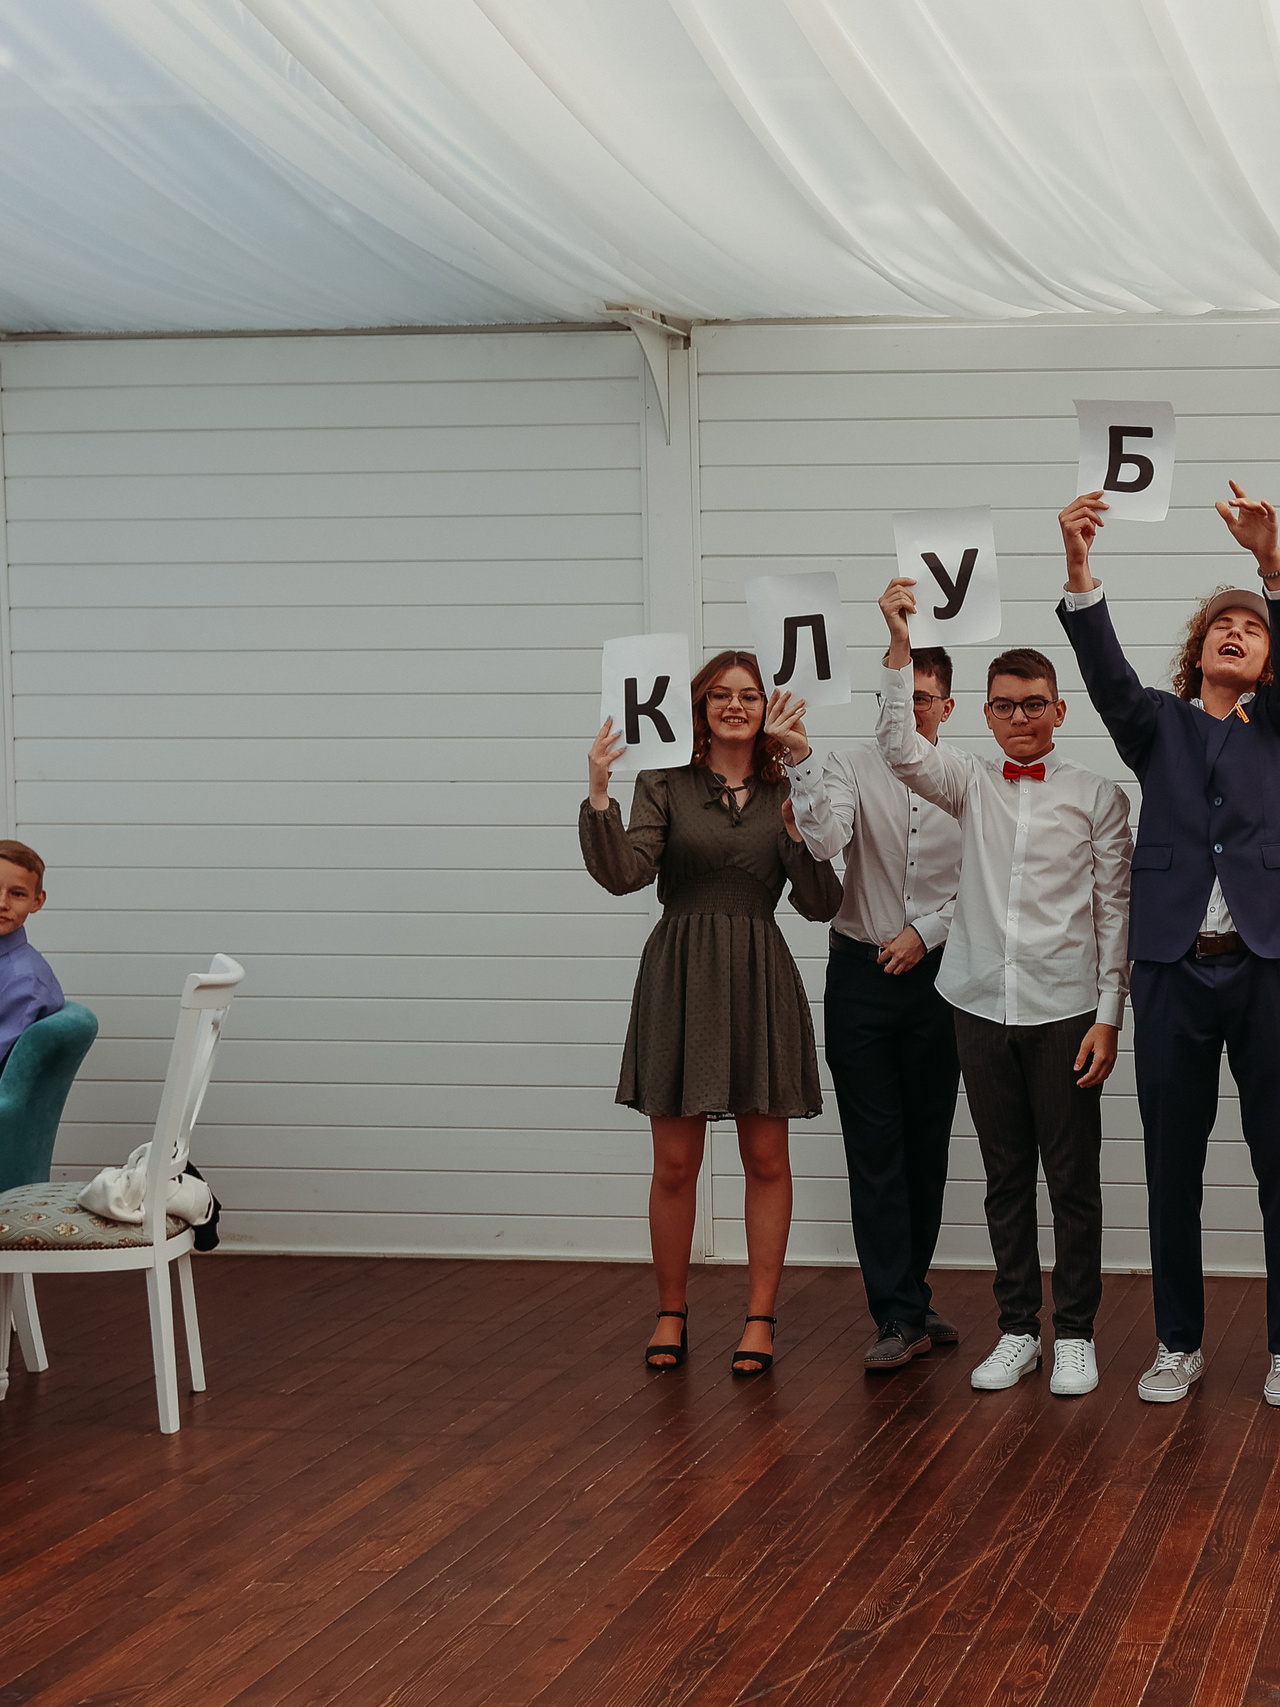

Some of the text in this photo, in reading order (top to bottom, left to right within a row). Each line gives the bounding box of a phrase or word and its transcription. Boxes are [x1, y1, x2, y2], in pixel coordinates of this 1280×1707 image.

[1102, 425, 1155, 493] Б
[920, 548, 979, 620] У
[772, 613, 832, 687] Л
[623, 675, 677, 745] К
